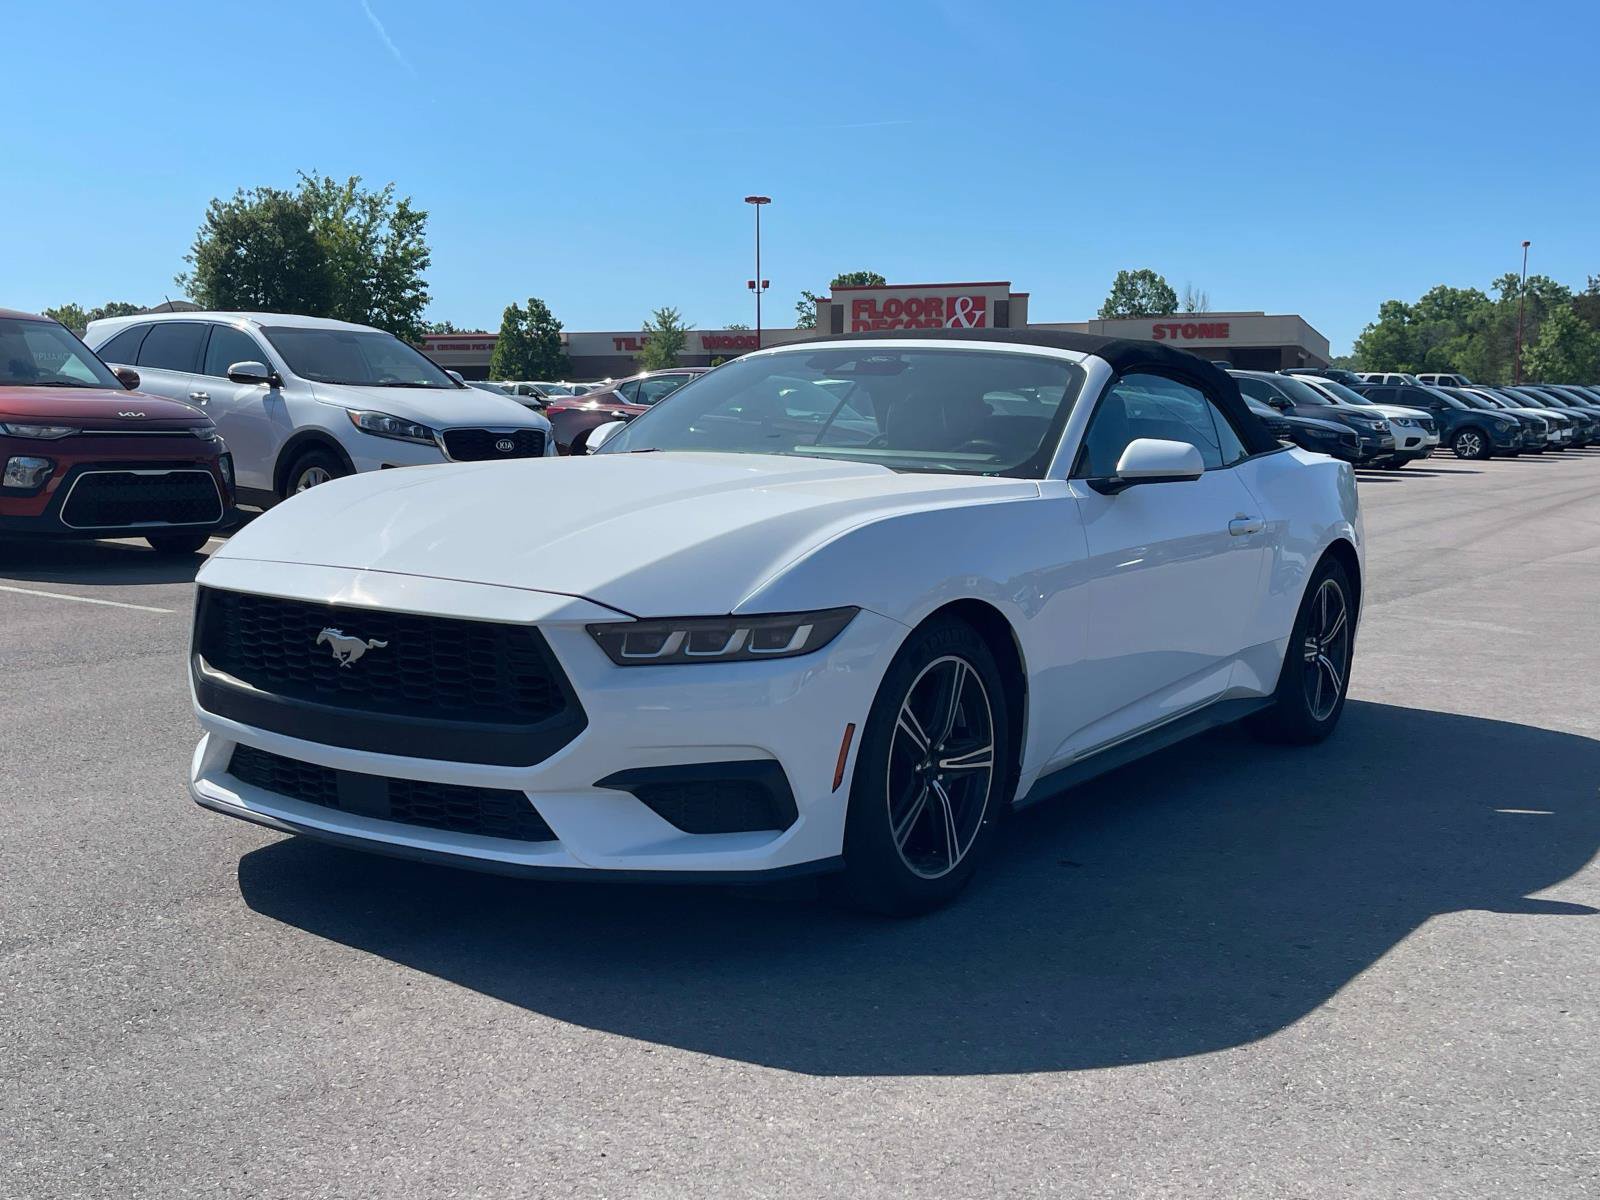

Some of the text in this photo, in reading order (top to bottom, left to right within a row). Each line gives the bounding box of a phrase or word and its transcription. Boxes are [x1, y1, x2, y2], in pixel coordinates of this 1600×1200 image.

[852, 297, 944, 319] FLOOR
[1152, 322, 1230, 340] STONE
[701, 335, 760, 350] WOOD
[498, 440, 513, 449] KIA
